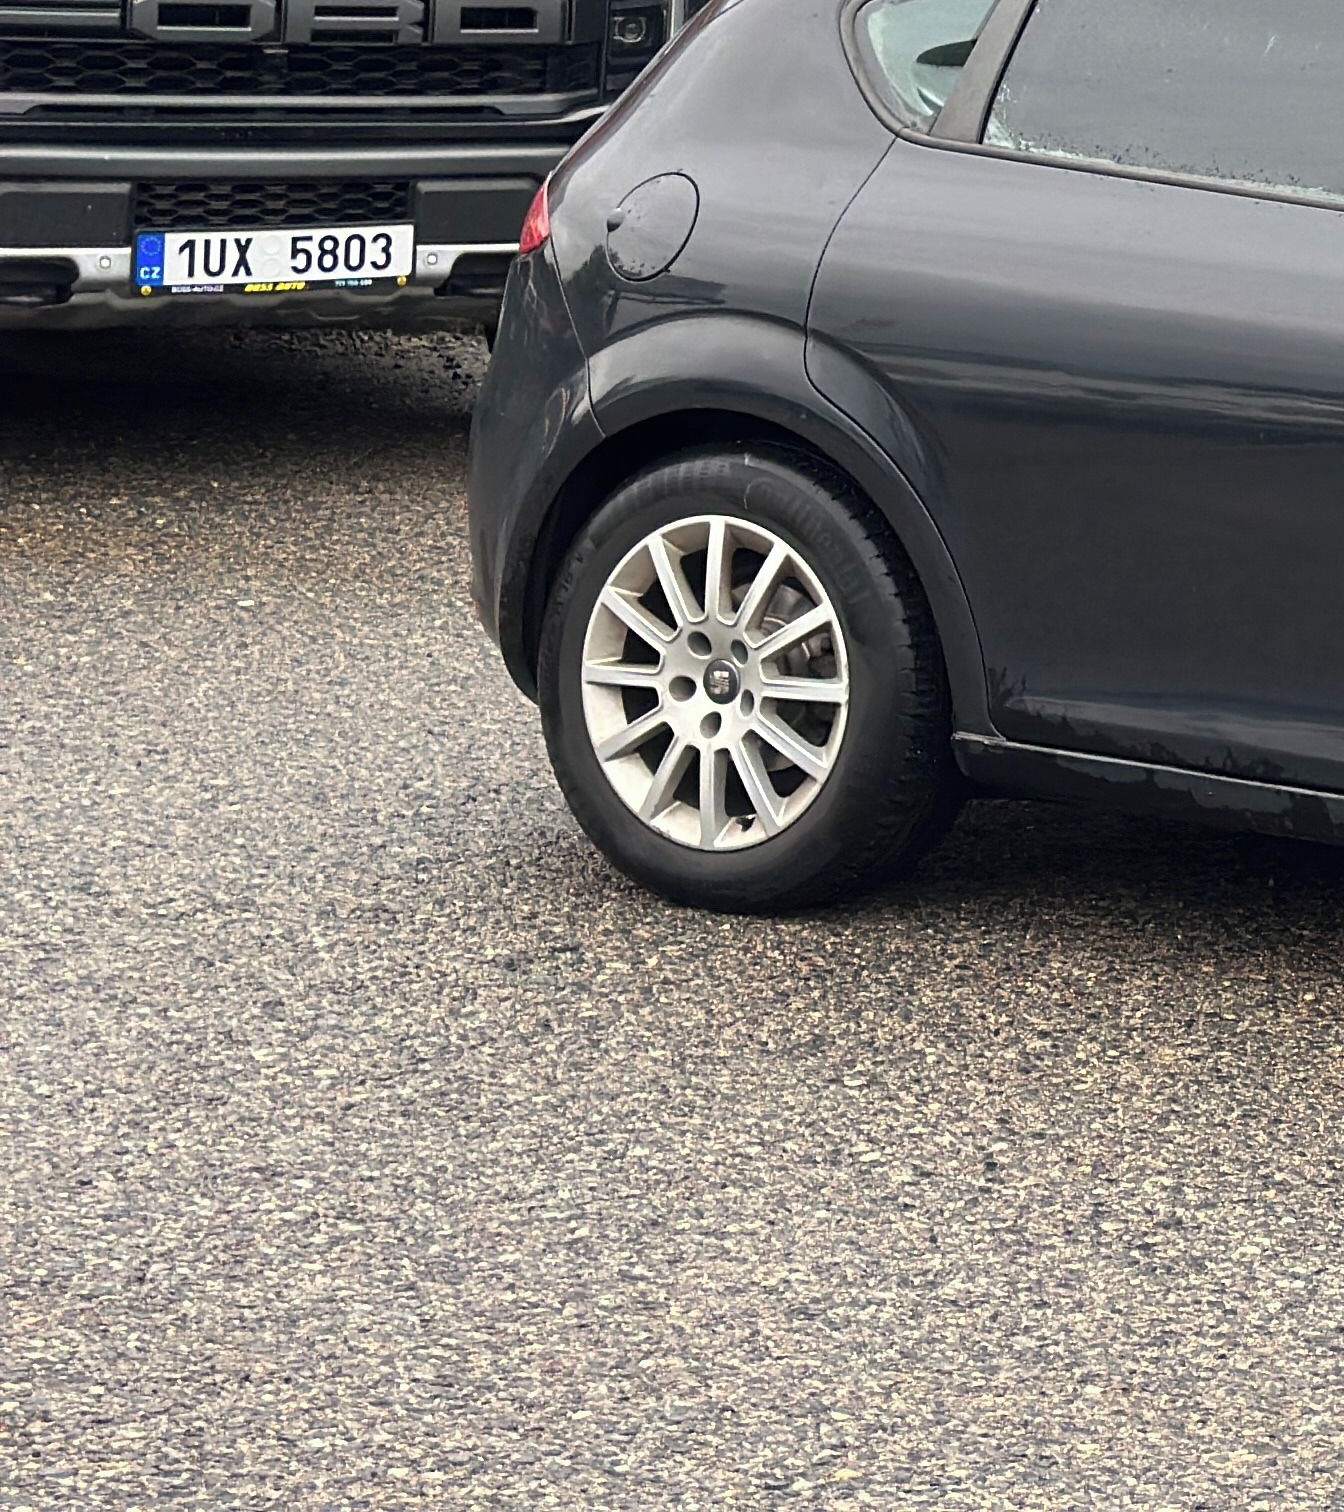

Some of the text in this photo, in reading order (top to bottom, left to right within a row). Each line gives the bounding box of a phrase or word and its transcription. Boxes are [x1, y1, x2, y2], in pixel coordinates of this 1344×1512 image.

[177, 232, 393, 278] 1UX 5803
[139, 266, 161, 280] CZ
